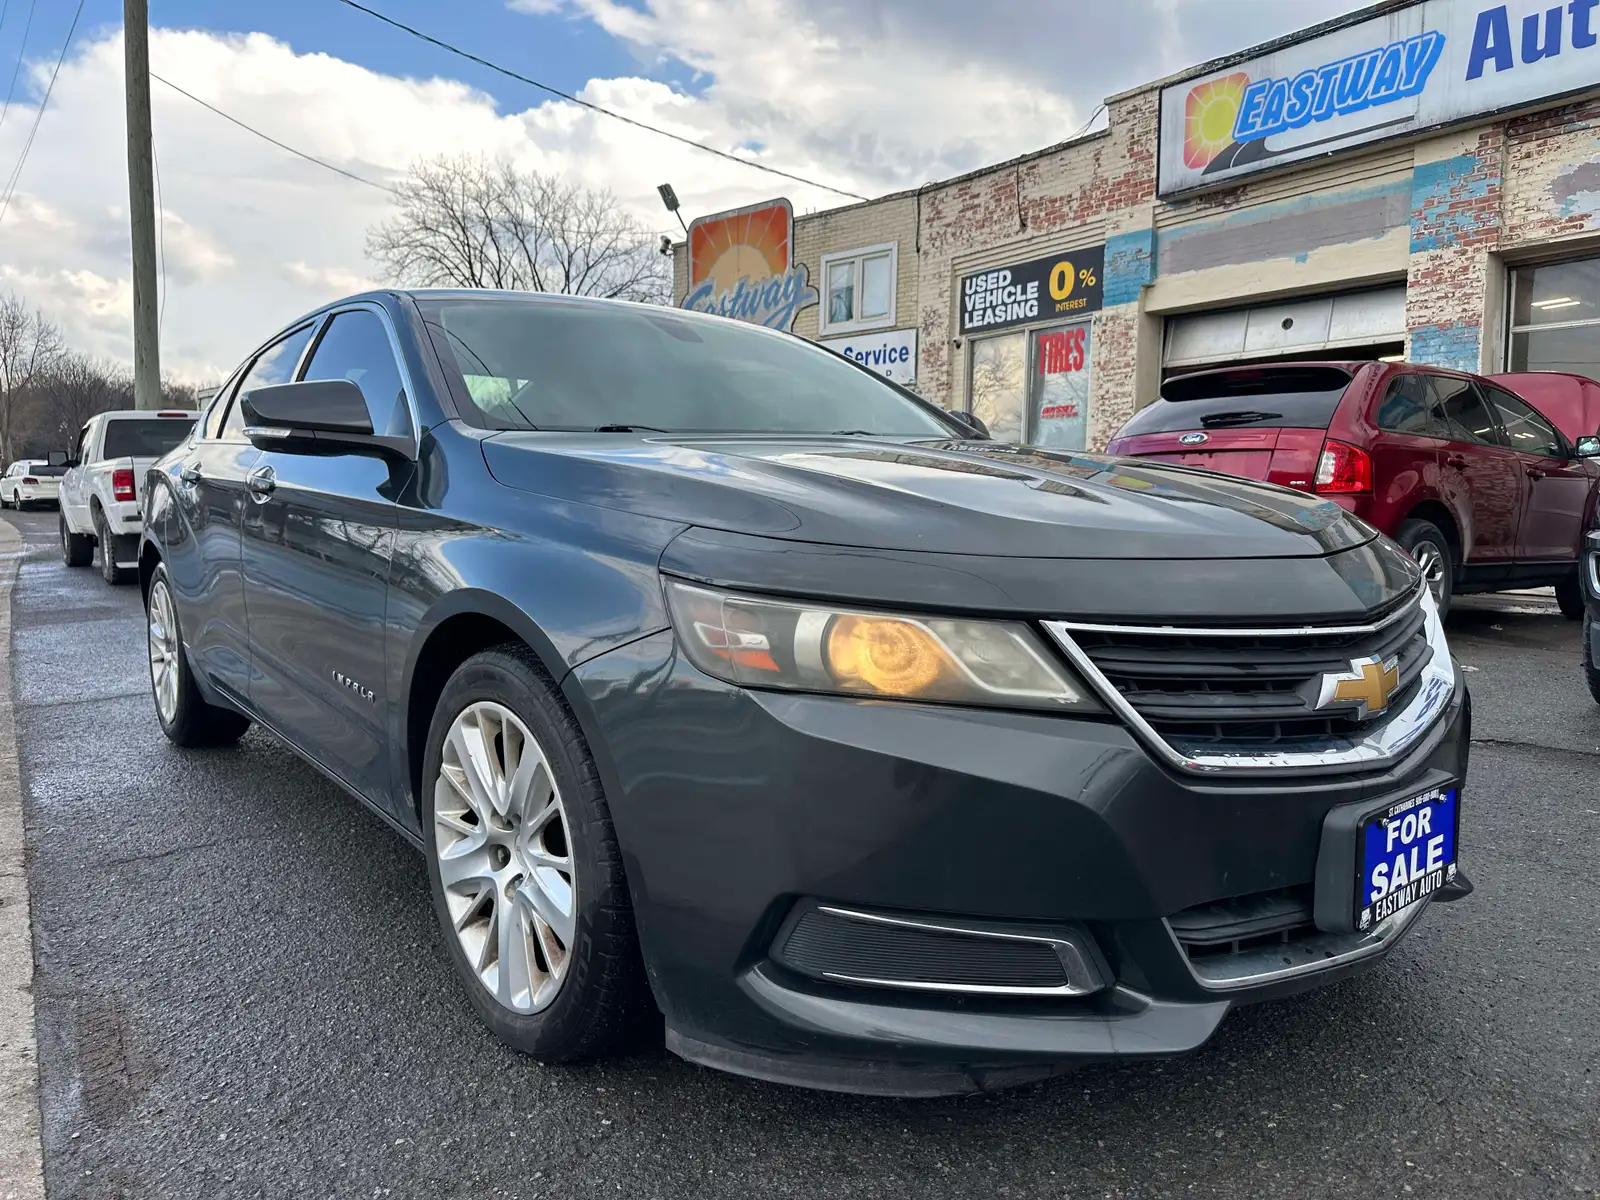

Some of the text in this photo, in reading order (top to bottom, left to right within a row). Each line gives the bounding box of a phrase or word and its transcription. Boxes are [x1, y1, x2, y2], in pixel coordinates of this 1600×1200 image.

[1232, 30, 1446, 143] EASTWAY
[964, 281, 1039, 311] VEHICLE
[965, 269, 1012, 295] USED
[1055, 298, 1087, 312] INTEREST
[964, 299, 1039, 329] LEASING
[1038, 327, 1085, 375] TIRES
[1386, 806, 1432, 853] FOR
[1370, 834, 1444, 903] SALE
[1375, 881, 1418, 922] EASTWAY
[1419, 869, 1442, 898] AUTO
